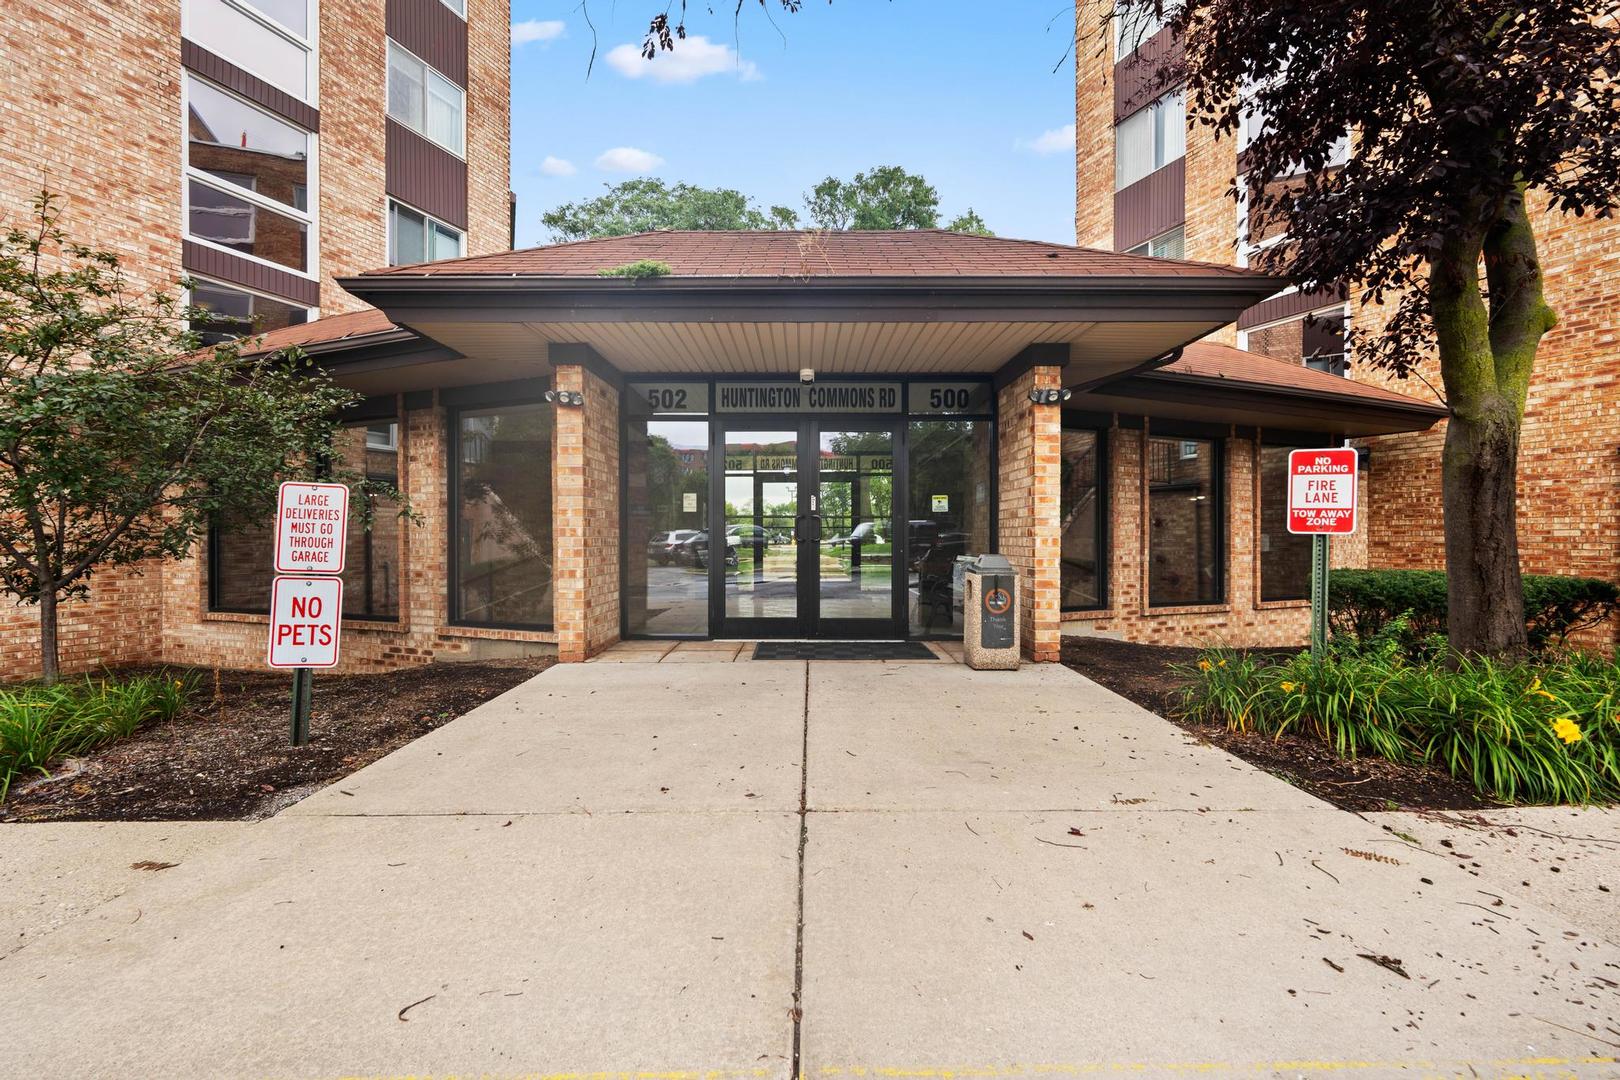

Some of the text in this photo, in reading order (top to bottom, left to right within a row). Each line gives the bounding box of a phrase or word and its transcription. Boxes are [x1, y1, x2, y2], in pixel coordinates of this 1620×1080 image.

[648, 389, 688, 409] 502
[721, 387, 896, 408] HUNTINGTON COMMONS RD
[930, 388, 970, 409] 500
[1314, 457, 1332, 465] NO
[1297, 465, 1349, 473] PARKING
[1308, 480, 1337, 491] FIRE
[298, 494, 330, 507] LARGE
[1305, 492, 1339, 503] LANE
[285, 508, 340, 521] DELIVERIES
[1292, 510, 1352, 518] TOW AWAY
[290, 522, 333, 535] MUST GO
[1306, 518, 1337, 526] ZONE
[289, 536, 334, 549] THROUGH
[291, 550, 329, 563] GARAGE
[291, 596, 322, 619] NO
[277, 624, 332, 646] PETS
